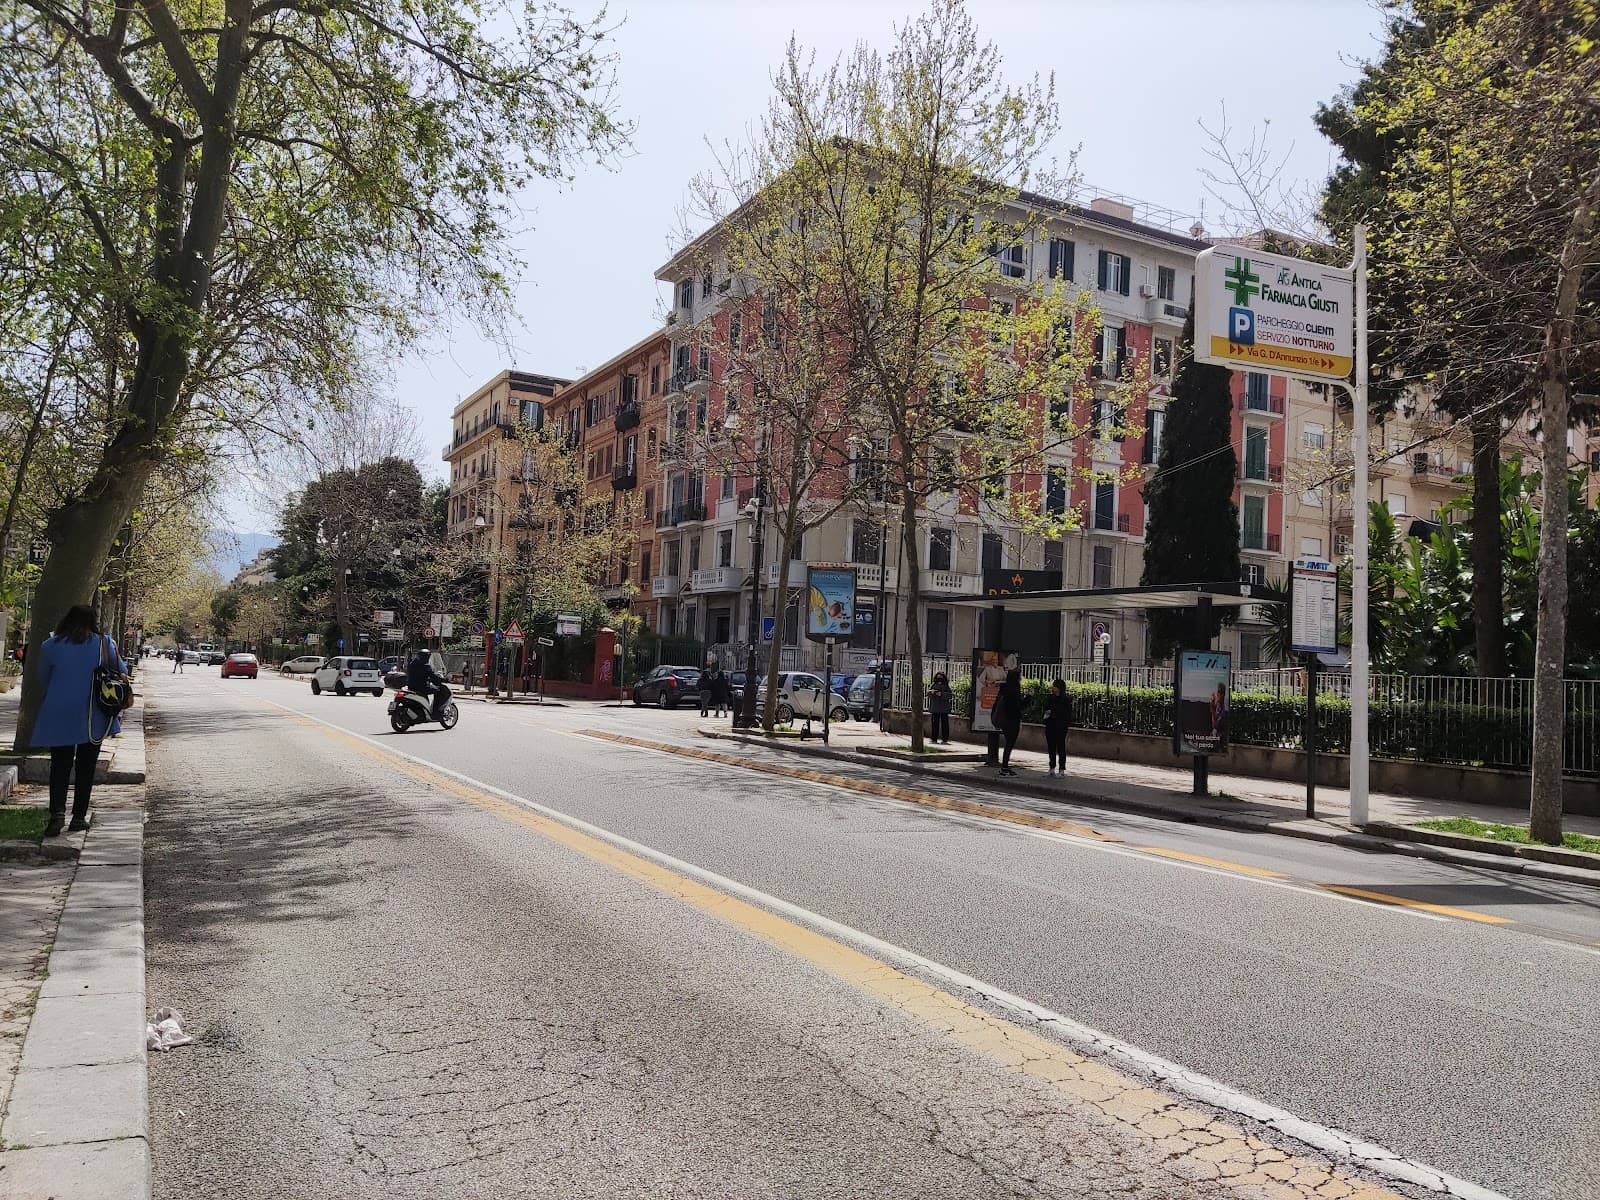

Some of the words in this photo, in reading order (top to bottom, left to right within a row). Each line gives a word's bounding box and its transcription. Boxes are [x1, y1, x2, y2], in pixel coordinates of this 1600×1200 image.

[1291, 273, 1322, 291] ANTICA
[1261, 284, 1307, 308] FARMACIA
[1308, 294, 1339, 314] GIUSTI
[1234, 313, 1250, 338] P
[1257, 314, 1304, 331] PARCHEGGIO
[1305, 324, 1334, 336] CLIENTI
[1257, 330, 1291, 344] SERVIZIO
[1292, 336, 1335, 352] NOTTURNO
[1248, 347, 1258, 357] Via
[1260, 349, 1268, 358] G.
[1270, 350, 1308, 364] D'Annunzio
